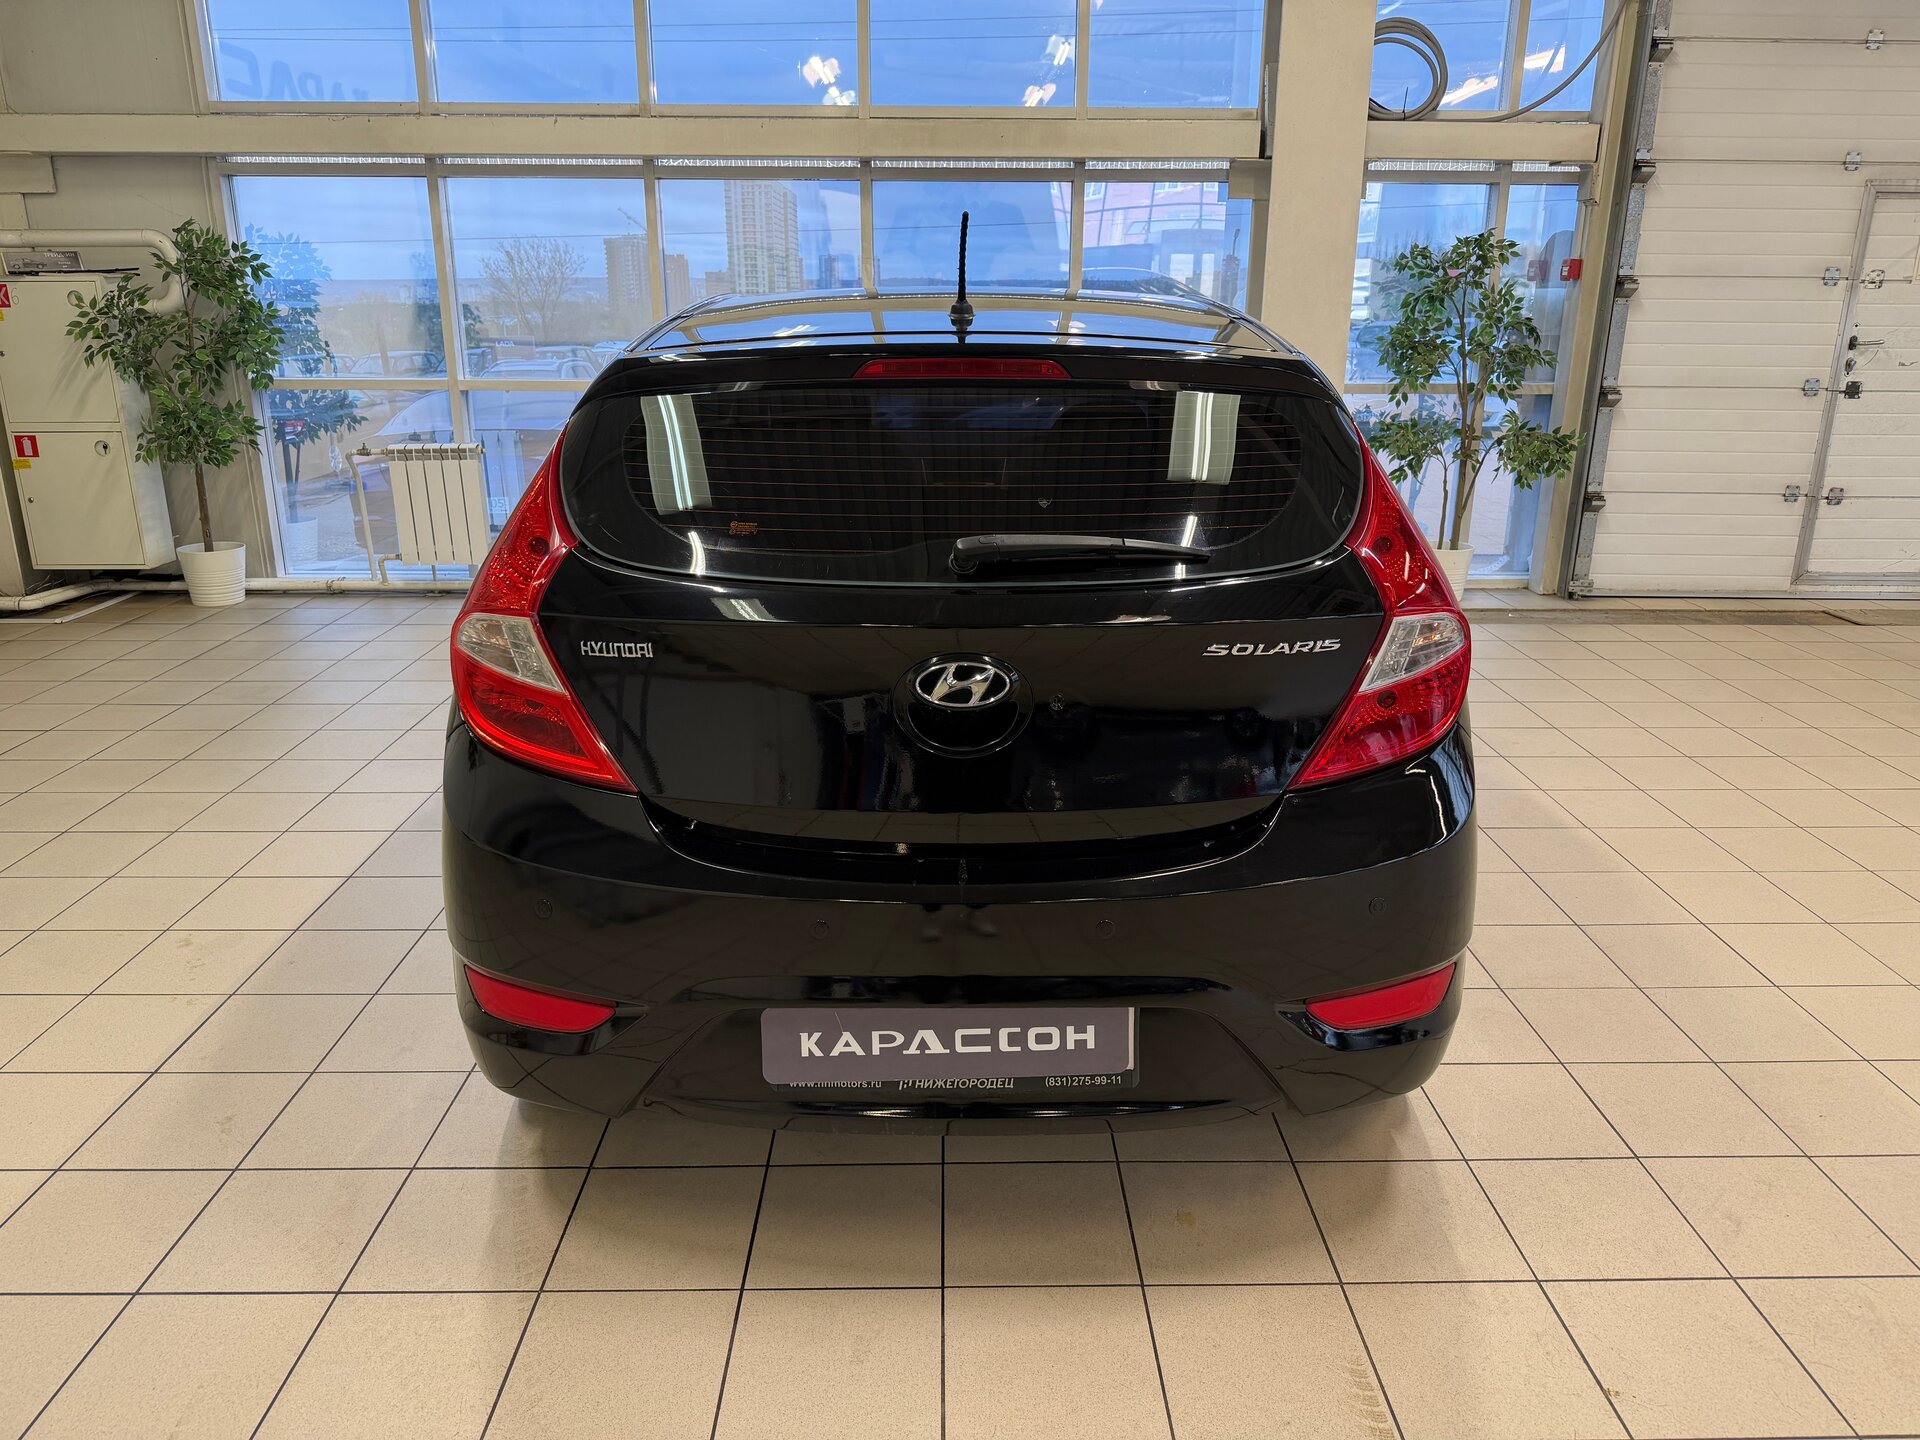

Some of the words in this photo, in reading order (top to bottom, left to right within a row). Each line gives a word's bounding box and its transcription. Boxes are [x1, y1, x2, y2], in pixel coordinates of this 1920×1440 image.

[580, 640, 654, 658] HYUNDAI
[1202, 638, 1342, 656] SOLARIS
[915, 1078, 1014, 1089] НИЖЕГОРОДЕЦ
